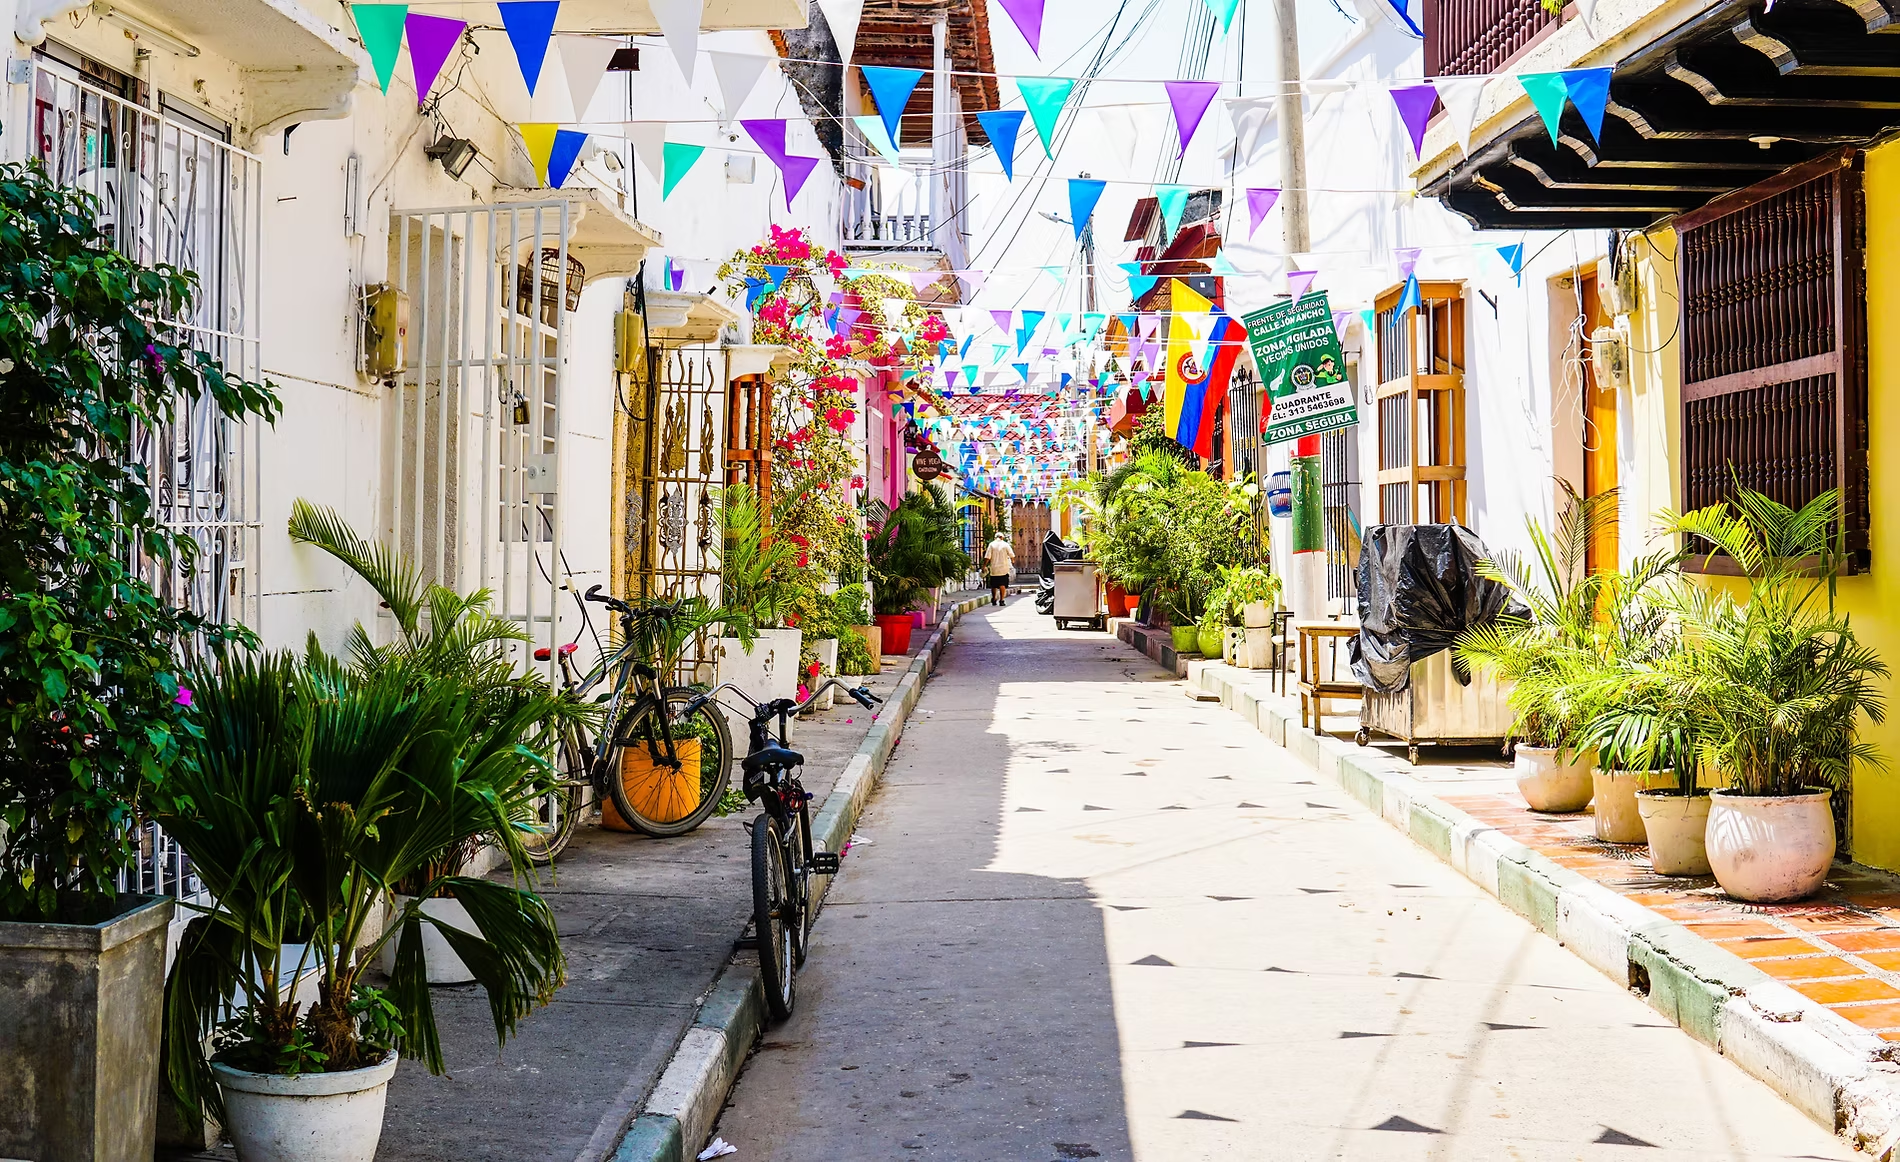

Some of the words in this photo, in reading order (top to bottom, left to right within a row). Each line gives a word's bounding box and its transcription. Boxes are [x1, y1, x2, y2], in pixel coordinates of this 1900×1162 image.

[1248, 314, 1275, 329] FRENTE
[1275, 310, 1287, 319] DE
[1286, 299, 1326, 315] SEGURIDAD
[1295, 308, 1326, 323] ANCHO
[1255, 339, 1287, 358] ZONA
[1294, 337, 1329, 352] UNIDOS
[1271, 412, 1287, 421] EL:
[1288, 407, 1305, 417] 313
[1307, 396, 1346, 412] 5463698
[1275, 391, 1332, 411] CUADRANTE
[1269, 425, 1304, 441] ZONA
[1305, 412, 1353, 431] SEGURA
